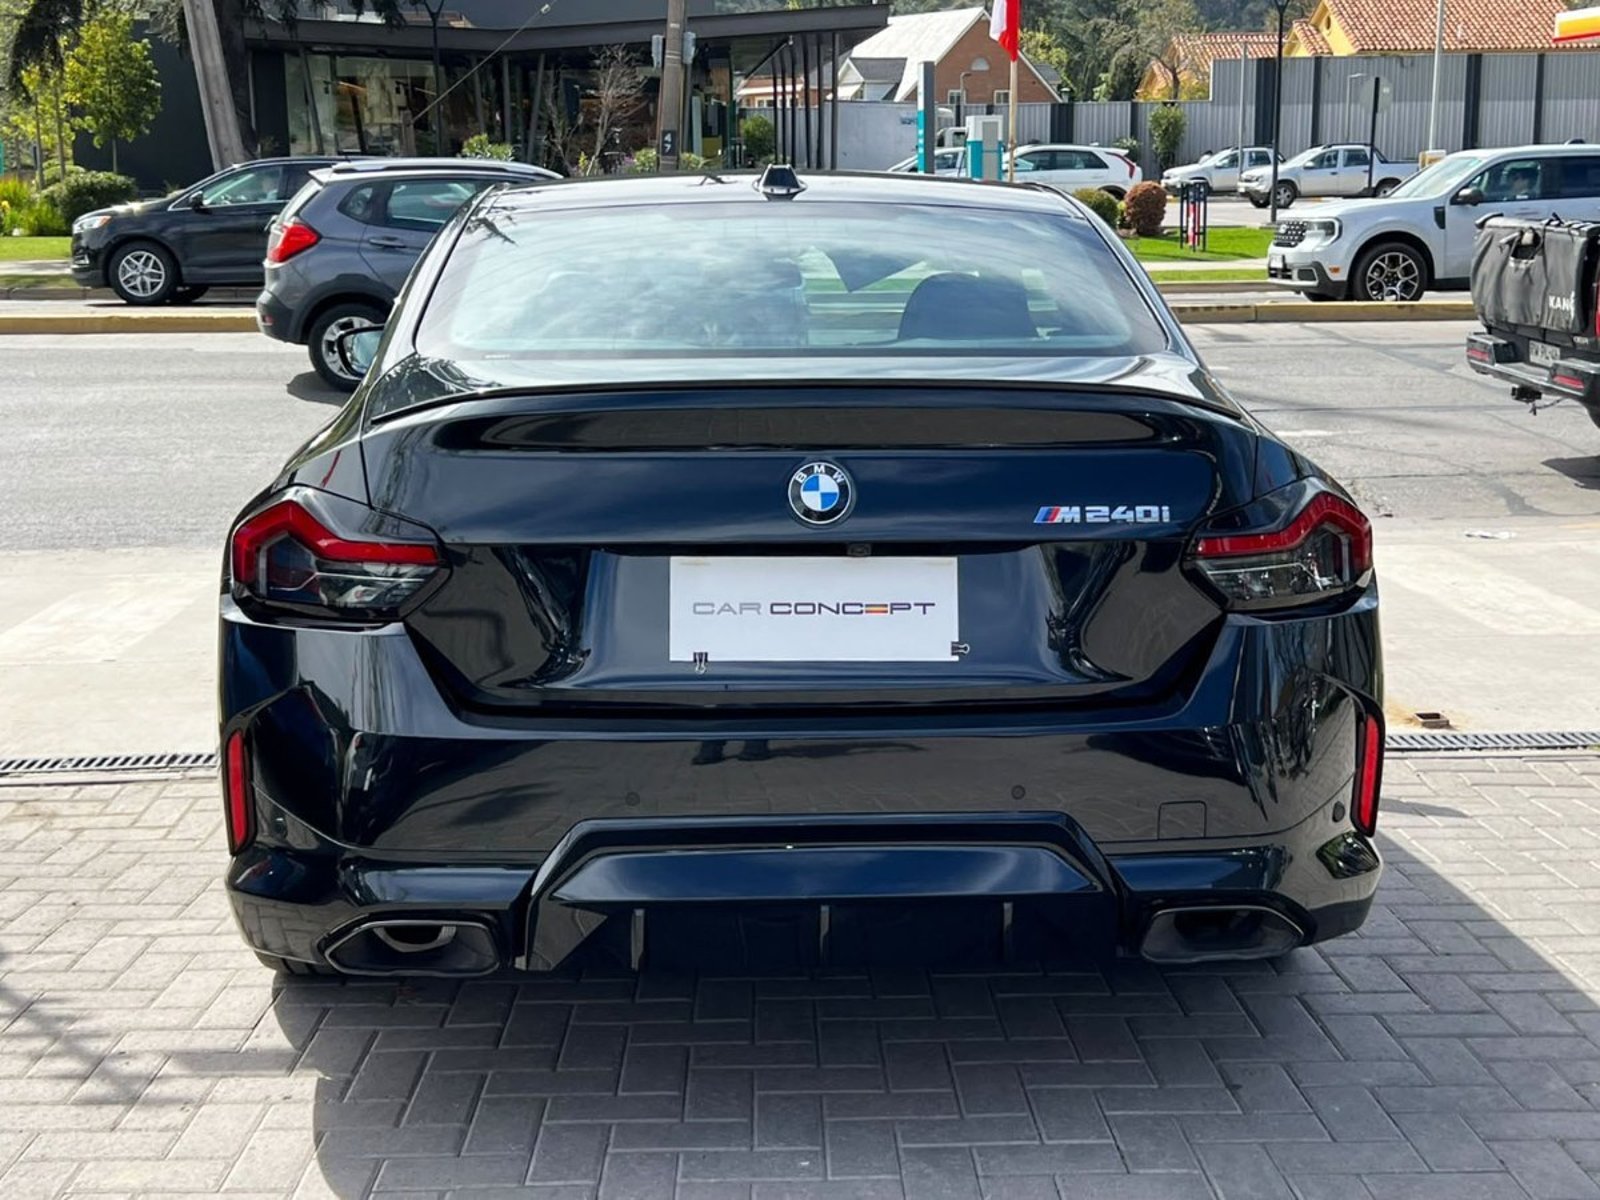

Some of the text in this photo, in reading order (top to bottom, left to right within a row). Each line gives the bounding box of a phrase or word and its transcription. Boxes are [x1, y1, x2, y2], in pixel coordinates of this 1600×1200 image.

[795, 464, 845, 483] BMW
[692, 602, 936, 615] CAR CONCEPT
